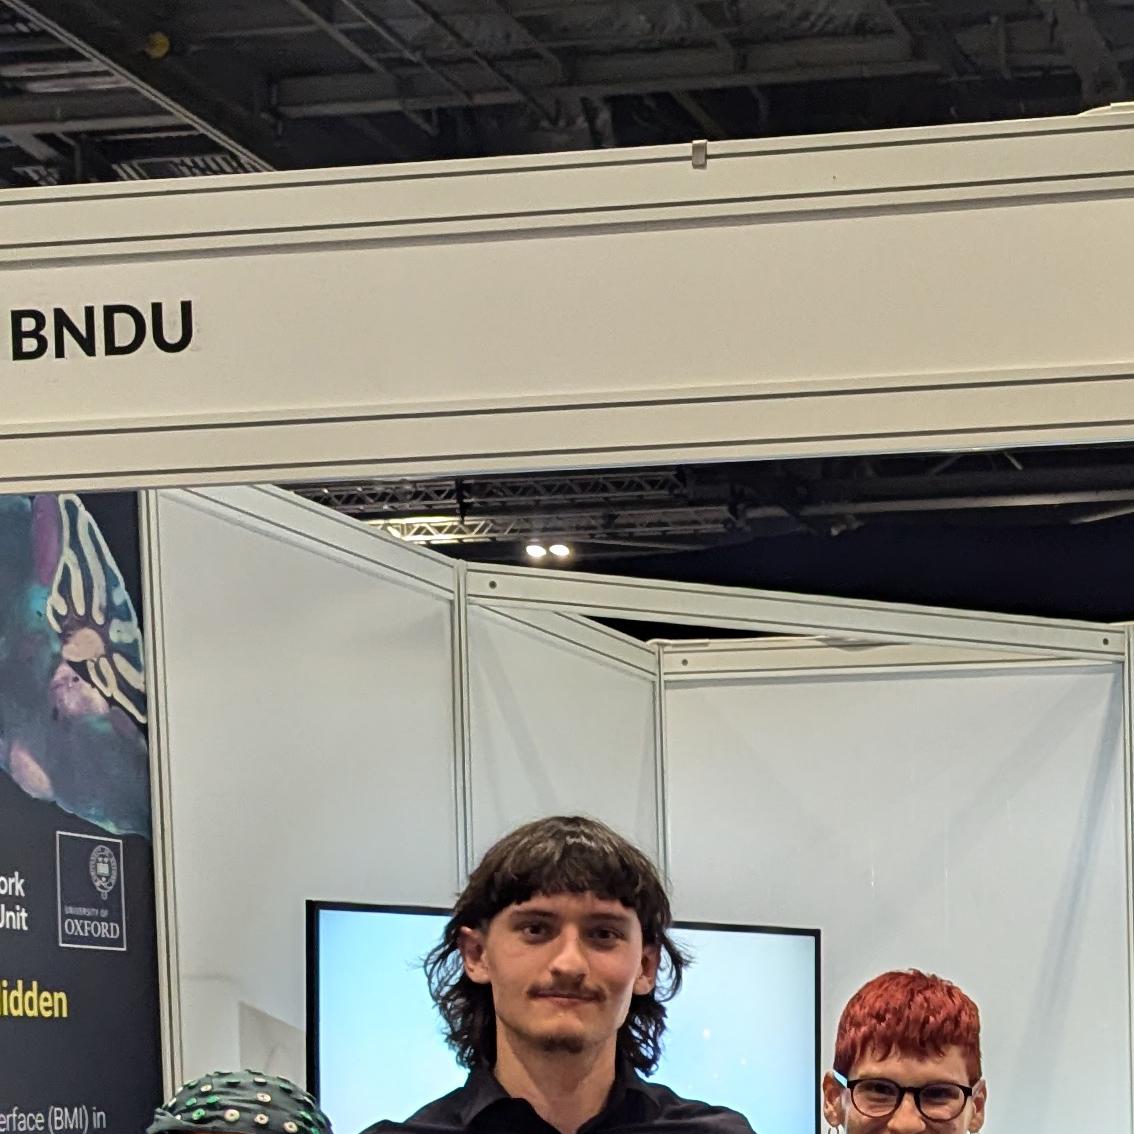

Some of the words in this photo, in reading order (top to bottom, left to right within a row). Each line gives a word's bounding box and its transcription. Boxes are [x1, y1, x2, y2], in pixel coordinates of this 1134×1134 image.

[11, 300, 193, 361] BNDU
[64, 918, 120, 939] OXFORD
[0, 980, 68, 1018] idden
[92, 1106, 106, 1129] in
